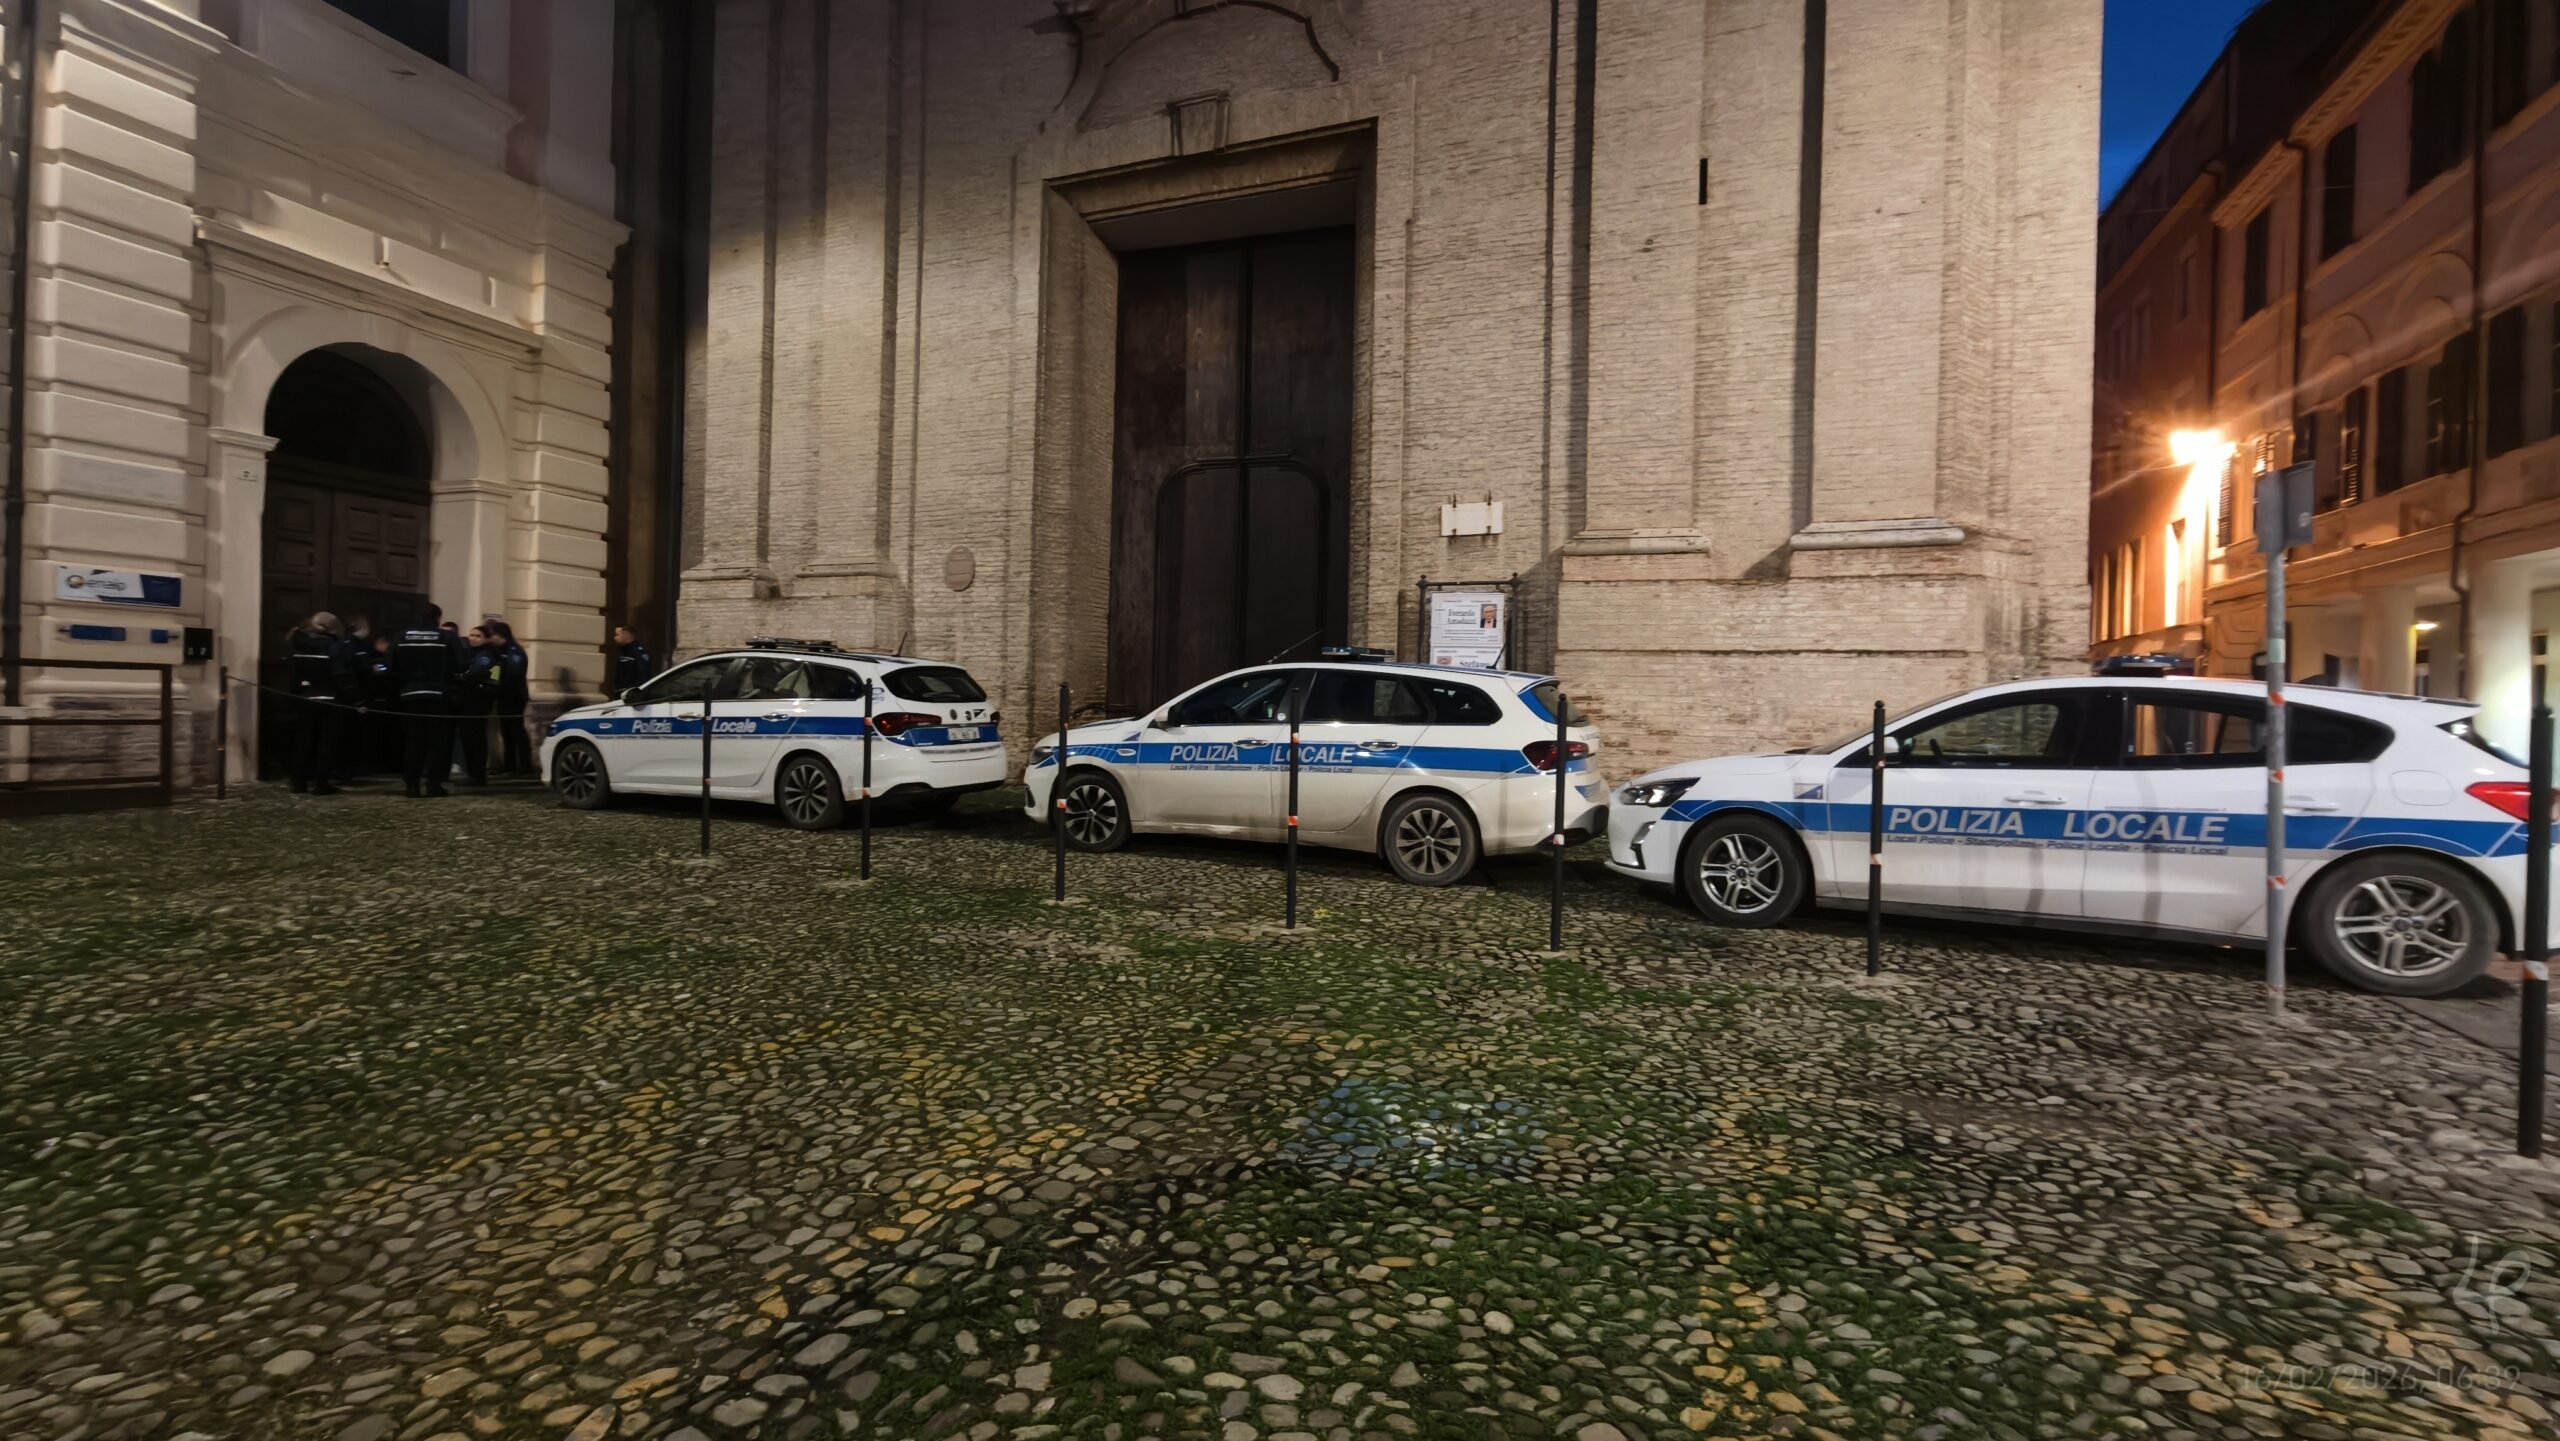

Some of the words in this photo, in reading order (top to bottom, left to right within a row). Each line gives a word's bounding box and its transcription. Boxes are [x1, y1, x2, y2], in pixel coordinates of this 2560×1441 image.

[631, 720, 672, 733] Polizia
[712, 718, 757, 733] Locale
[1170, 745, 1239, 761] POLIZIA
[1888, 808, 2025, 835] POLIZIA
[2063, 812, 2229, 842] LOCALE
[1887, 835, 1917, 843] Local
[1920, 836, 1954, 845] Police
[2047, 840, 2083, 849] Police
[2089, 842, 2129, 851] Locale
[2191, 845, 2228, 855] Local
